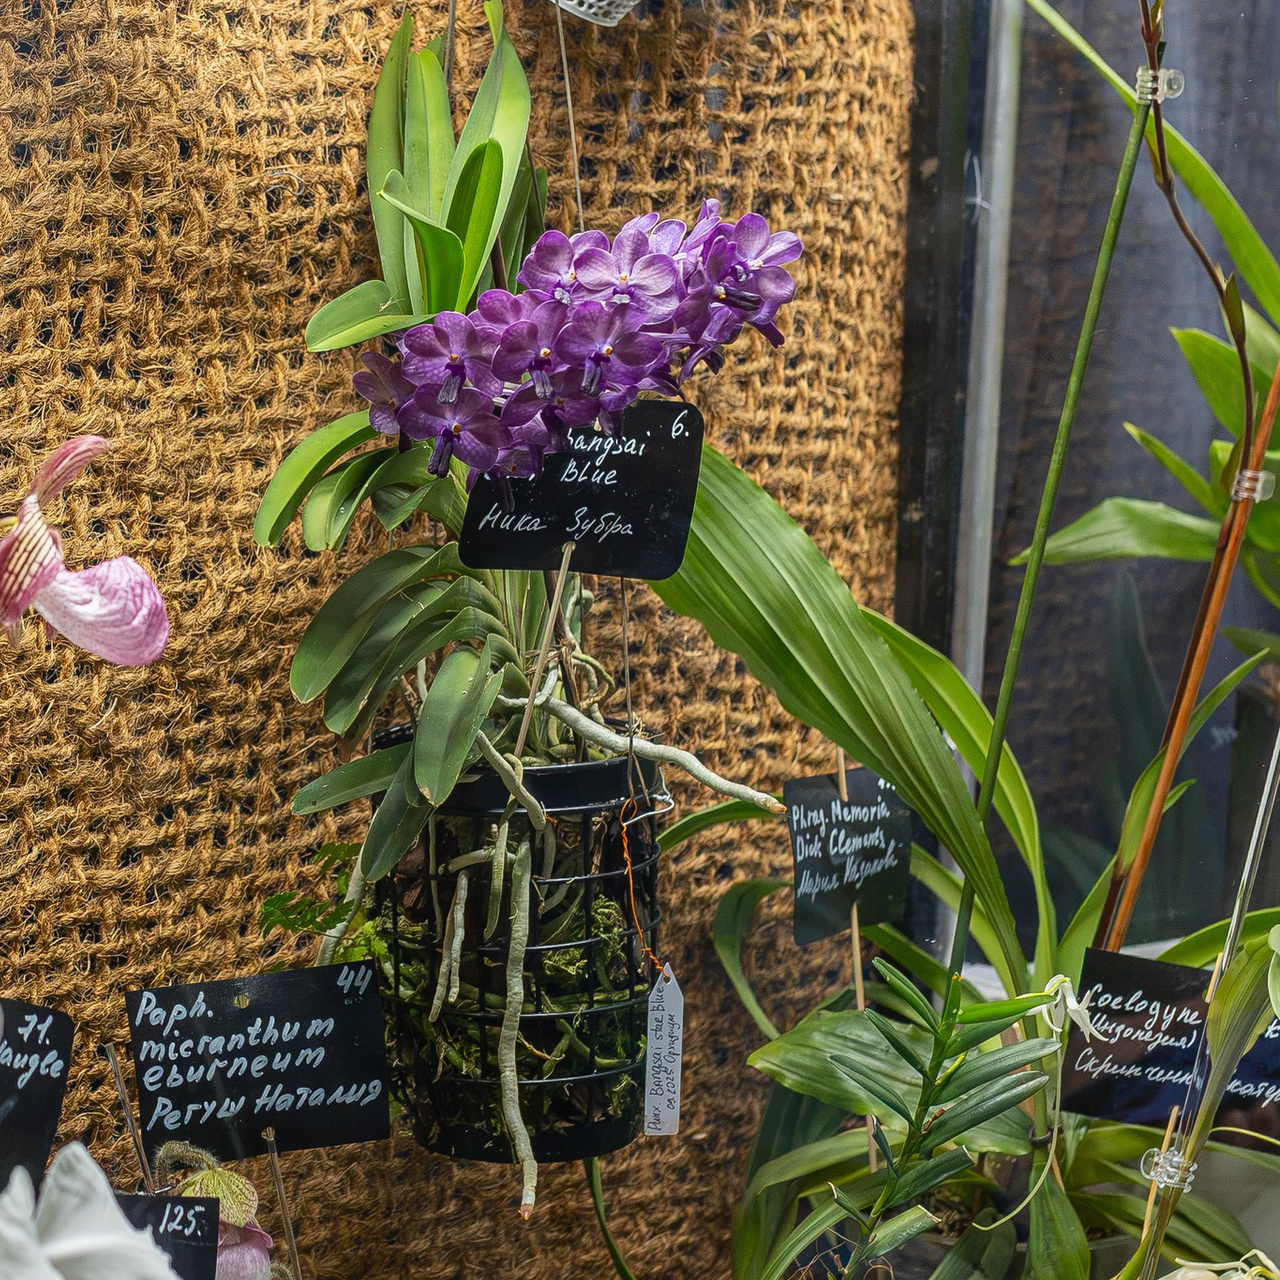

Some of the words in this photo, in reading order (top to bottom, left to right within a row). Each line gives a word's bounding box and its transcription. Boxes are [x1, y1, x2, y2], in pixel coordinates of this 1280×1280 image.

[134, 991, 214, 1037] Paph.
[139, 1016, 335, 1062] micranthum
[142, 1047, 326, 1092] eburneum
[253, 1079, 382, 1114] Наталия
